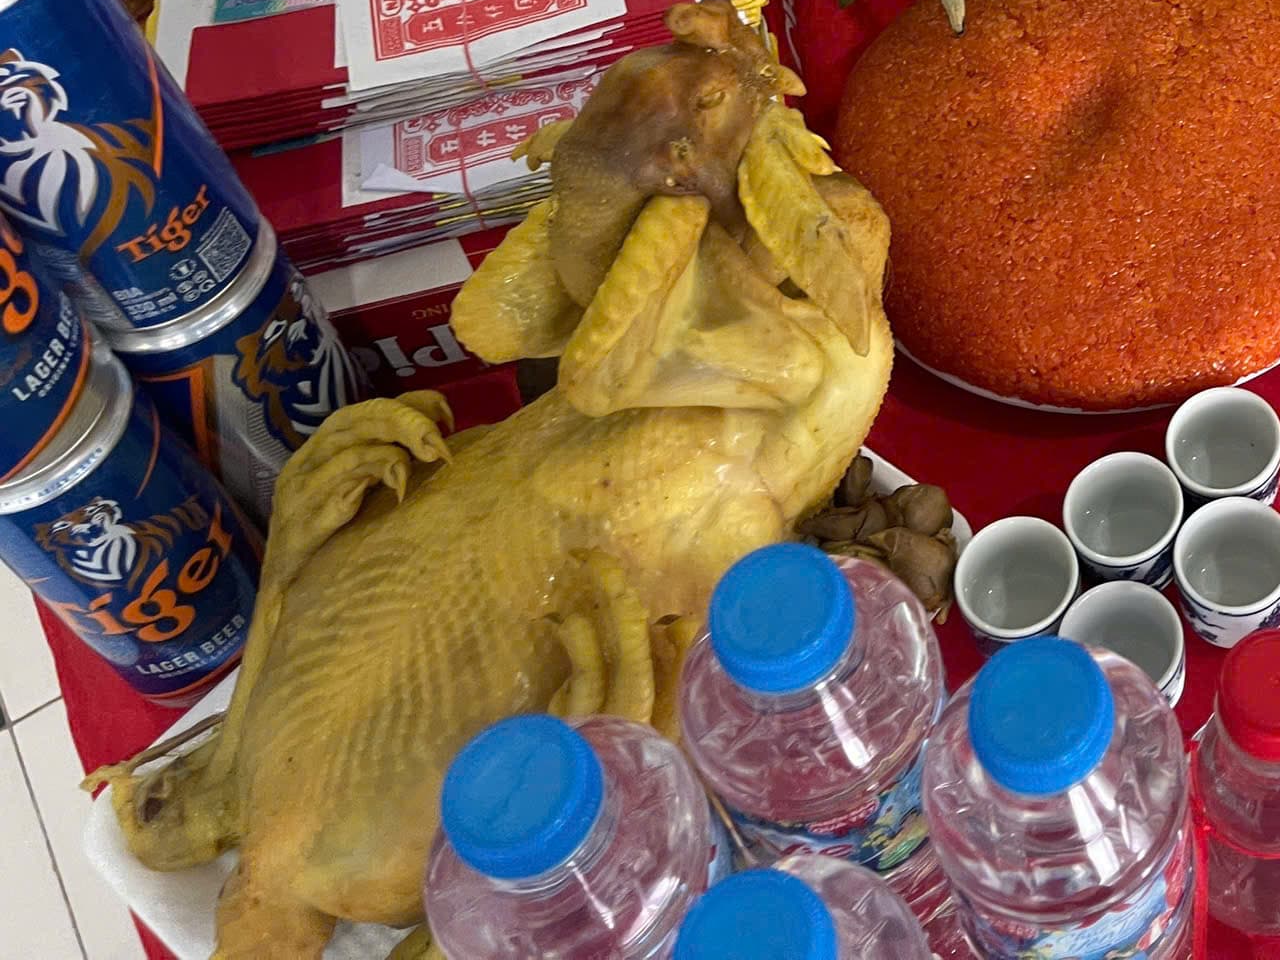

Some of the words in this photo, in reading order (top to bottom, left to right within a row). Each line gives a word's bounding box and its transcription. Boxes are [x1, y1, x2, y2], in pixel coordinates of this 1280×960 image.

[114, 184, 210, 263] Tiger
[12, 337, 65, 402] LAGER
[46, 499, 233, 642] Tiger
[136, 650, 201, 676] LAGER
[202, 614, 246, 655] BEER
